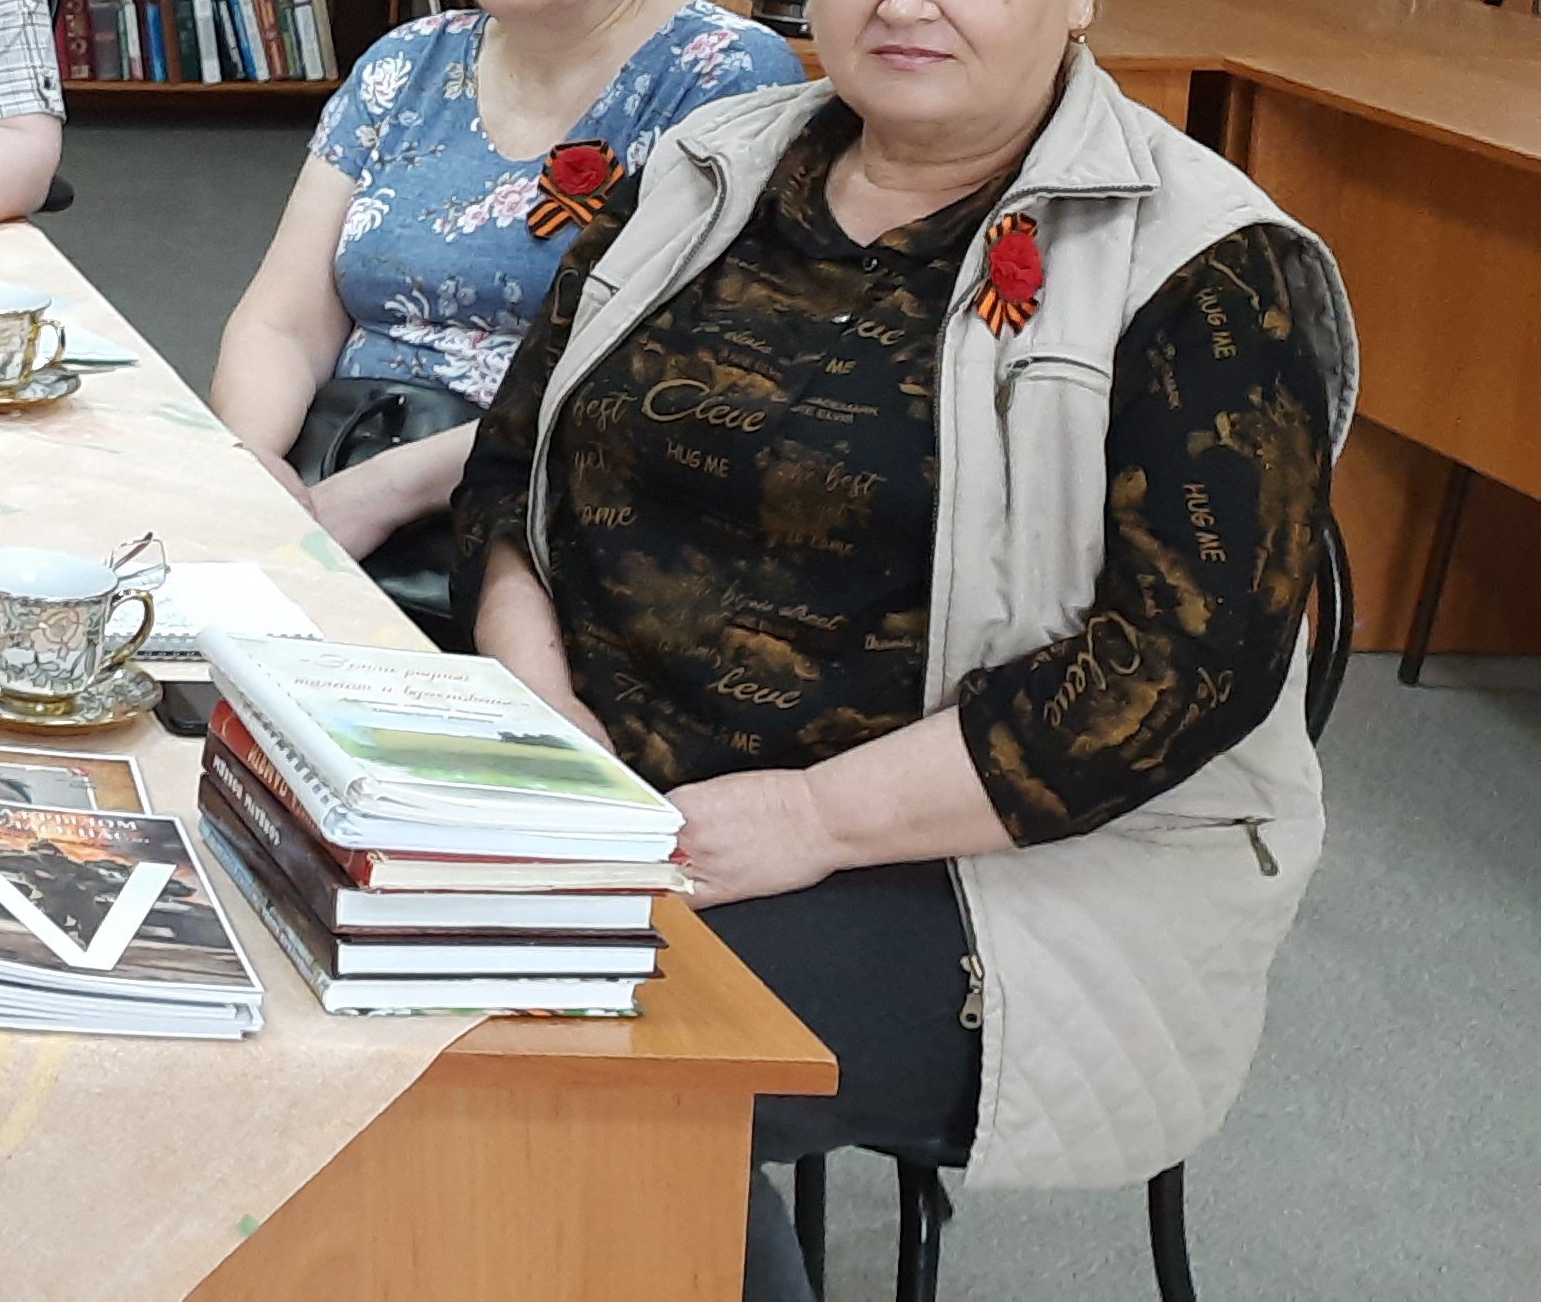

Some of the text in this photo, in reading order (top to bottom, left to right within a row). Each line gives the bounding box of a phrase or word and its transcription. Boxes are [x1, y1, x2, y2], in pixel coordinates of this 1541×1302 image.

[666, 437, 730, 478] HUG ME
[1181, 482, 1228, 563] HUG ME
[730, 729, 763, 756] ME
